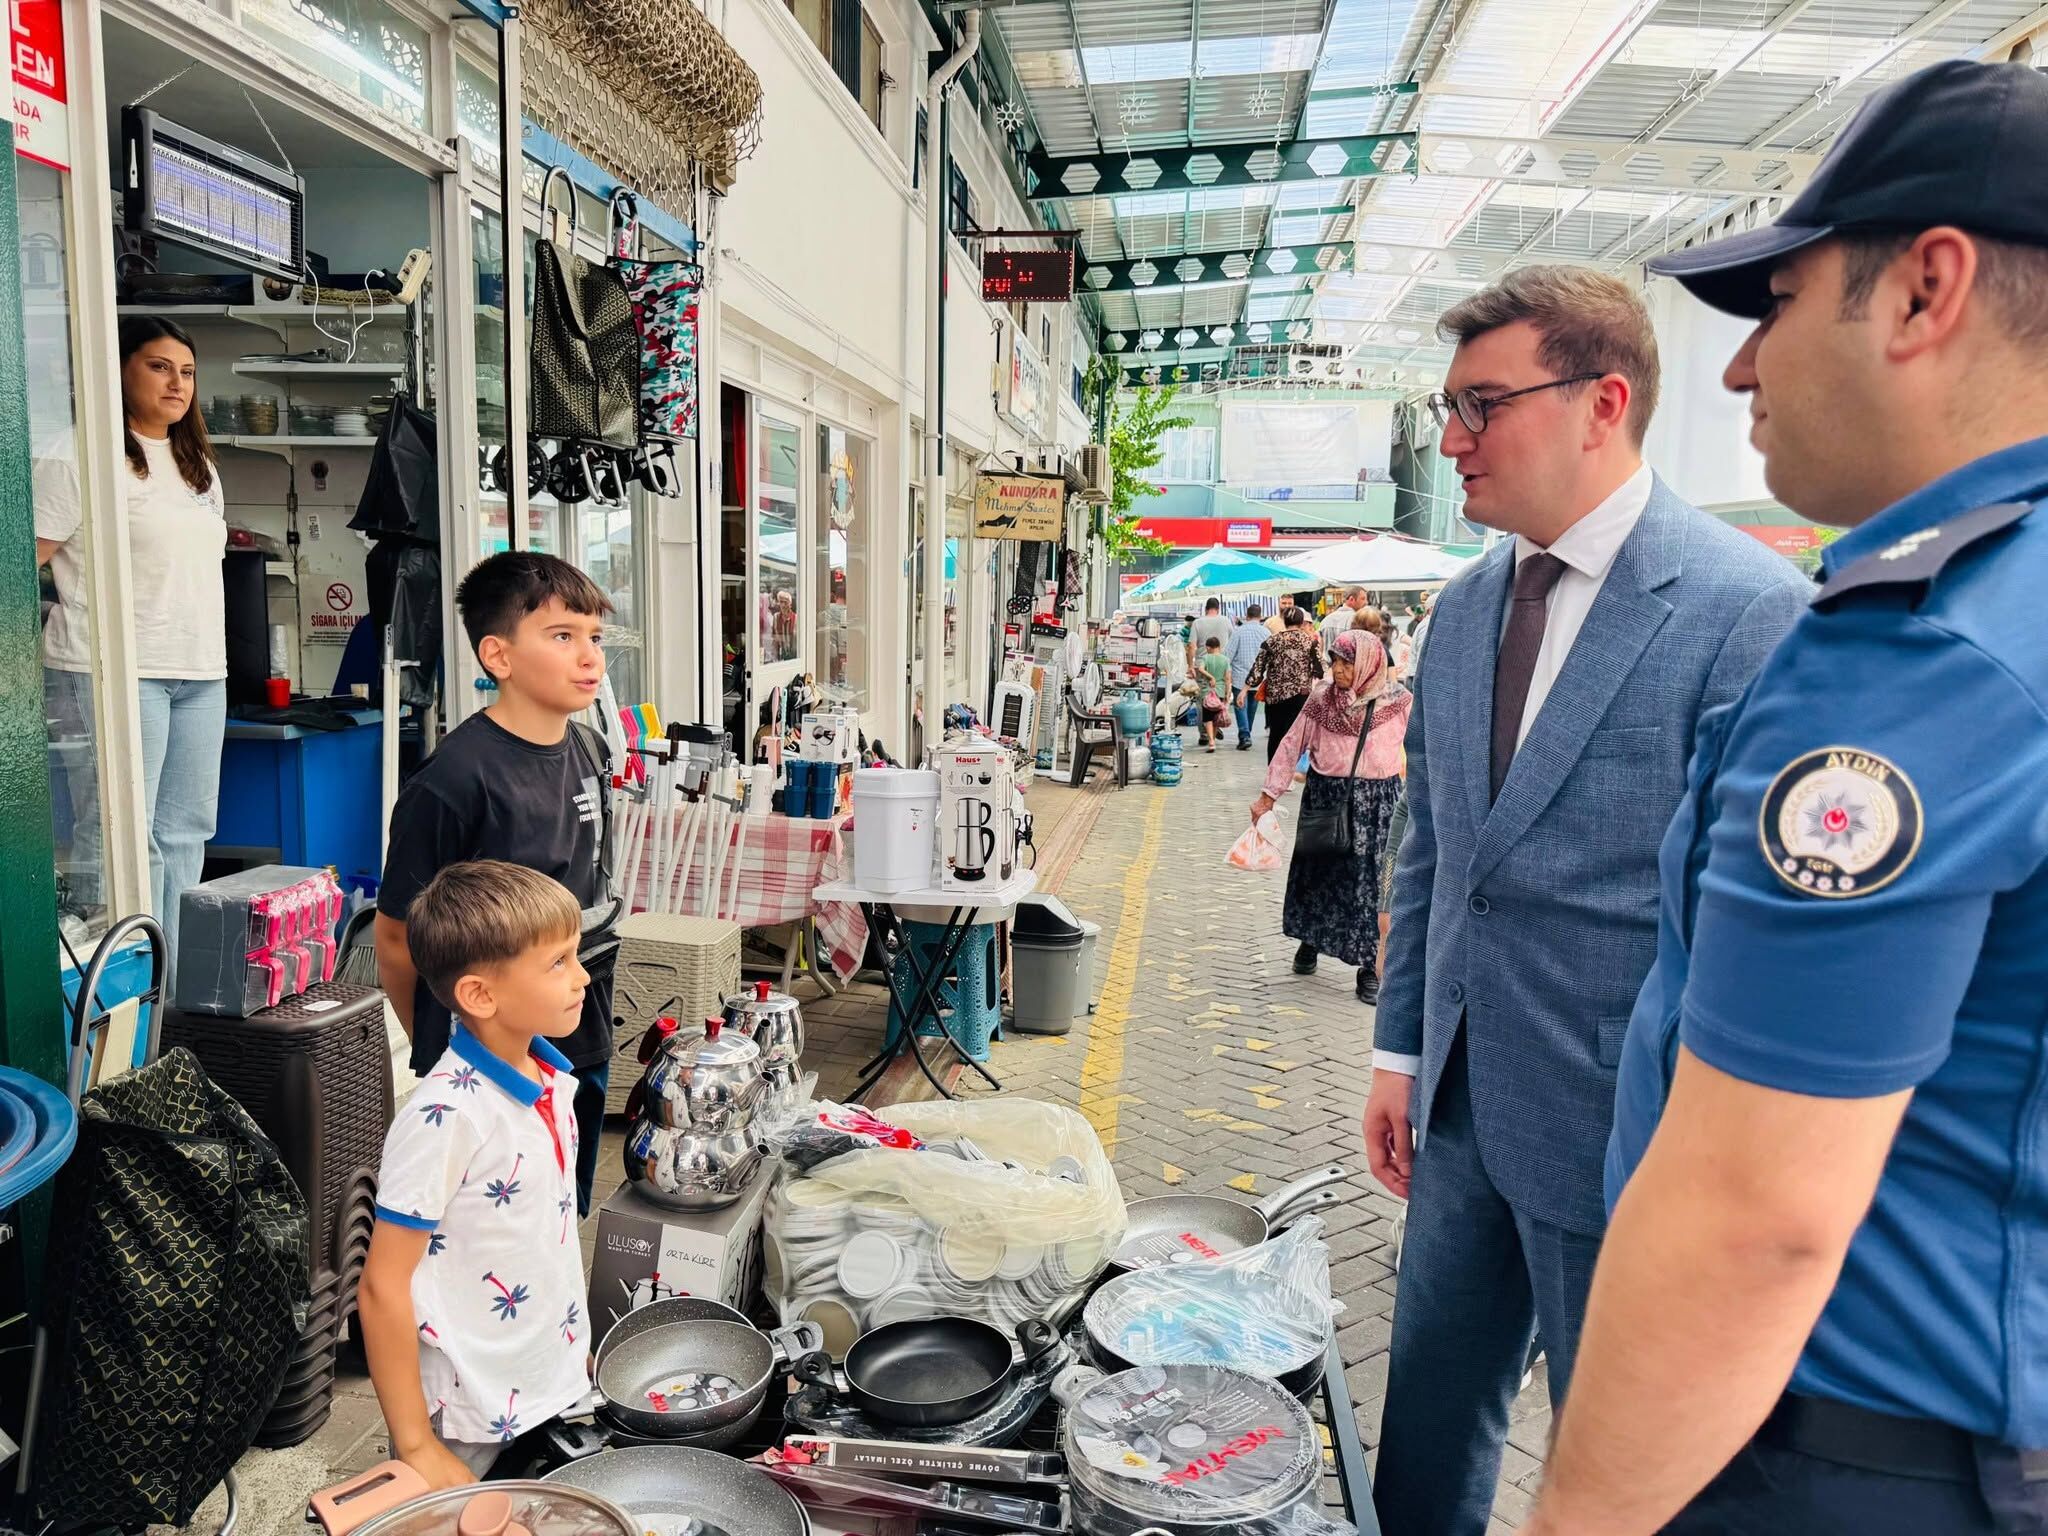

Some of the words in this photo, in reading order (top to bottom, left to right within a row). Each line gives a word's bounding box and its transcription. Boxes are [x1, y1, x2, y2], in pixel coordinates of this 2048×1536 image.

[11, 40, 56, 88] EN
[311, 612, 338, 627] SİGARA
[607, 1233, 655, 1253] ULUSOY
[1177, 1231, 1223, 1260] MEHT
[631, 1249, 651, 1257] TURKEY
[666, 1248, 690, 1261] ORTA
[853, 1454, 888, 1465] İMALAT
[890, 1456, 913, 1467] ÖZEL
[919, 1459, 963, 1470] ÇELİKTEN
[969, 1463, 1000, 1473] DÖVME
